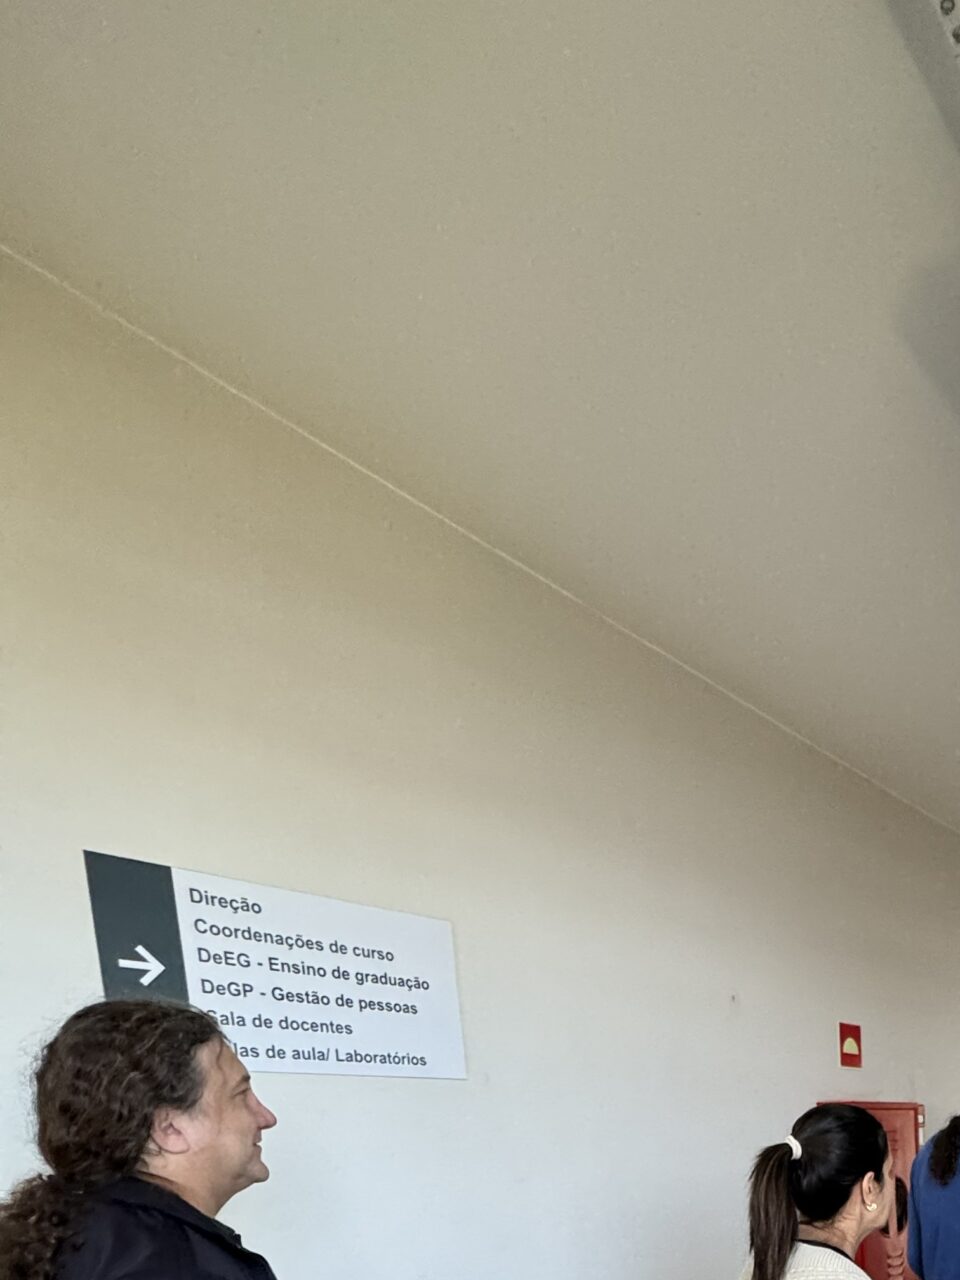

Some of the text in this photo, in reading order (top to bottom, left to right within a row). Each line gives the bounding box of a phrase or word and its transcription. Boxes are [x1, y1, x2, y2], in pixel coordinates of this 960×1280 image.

[188, 887, 262, 914] Direção
[194, 918, 395, 961] Coordenações de curso
[197, 947, 251, 968] DeEG
[268, 957, 327, 978] Ensino
[331, 966, 350, 980] de
[355, 972, 430, 991] graduação
[201, 978, 254, 998] DeGP
[271, 987, 331, 1006] Gestão
[335, 994, 354, 1008] de
[358, 998, 418, 1015] pessoas
[252, 1013, 273, 1029] de
[278, 1016, 353, 1035] docentes
[265, 1045, 286, 1060] de
[291, 1047, 330, 1062] aula/
[335, 1048, 428, 1066] Laboratórios
